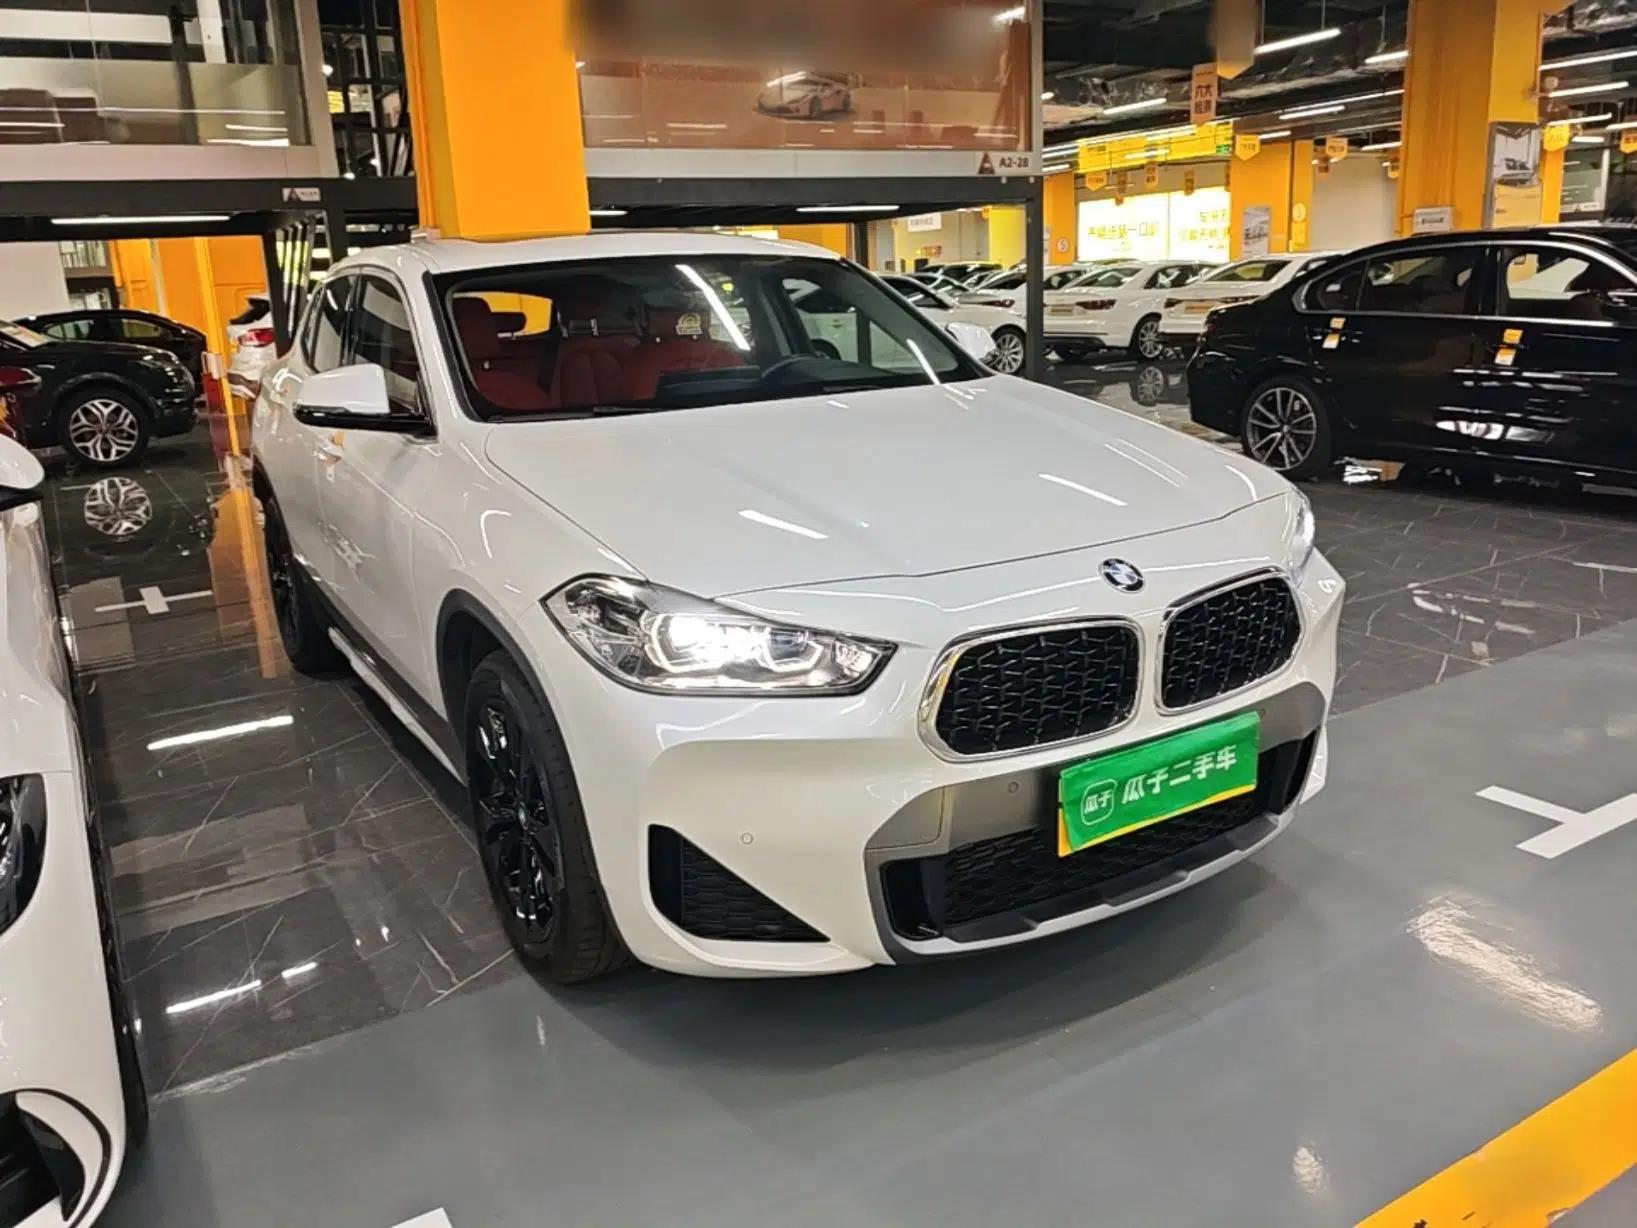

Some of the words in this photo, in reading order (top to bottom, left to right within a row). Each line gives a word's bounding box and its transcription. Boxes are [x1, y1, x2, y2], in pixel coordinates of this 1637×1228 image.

[1122, 744, 1237, 804] 瓜子二手车
[1084, 790, 1112, 813] 瓜子
